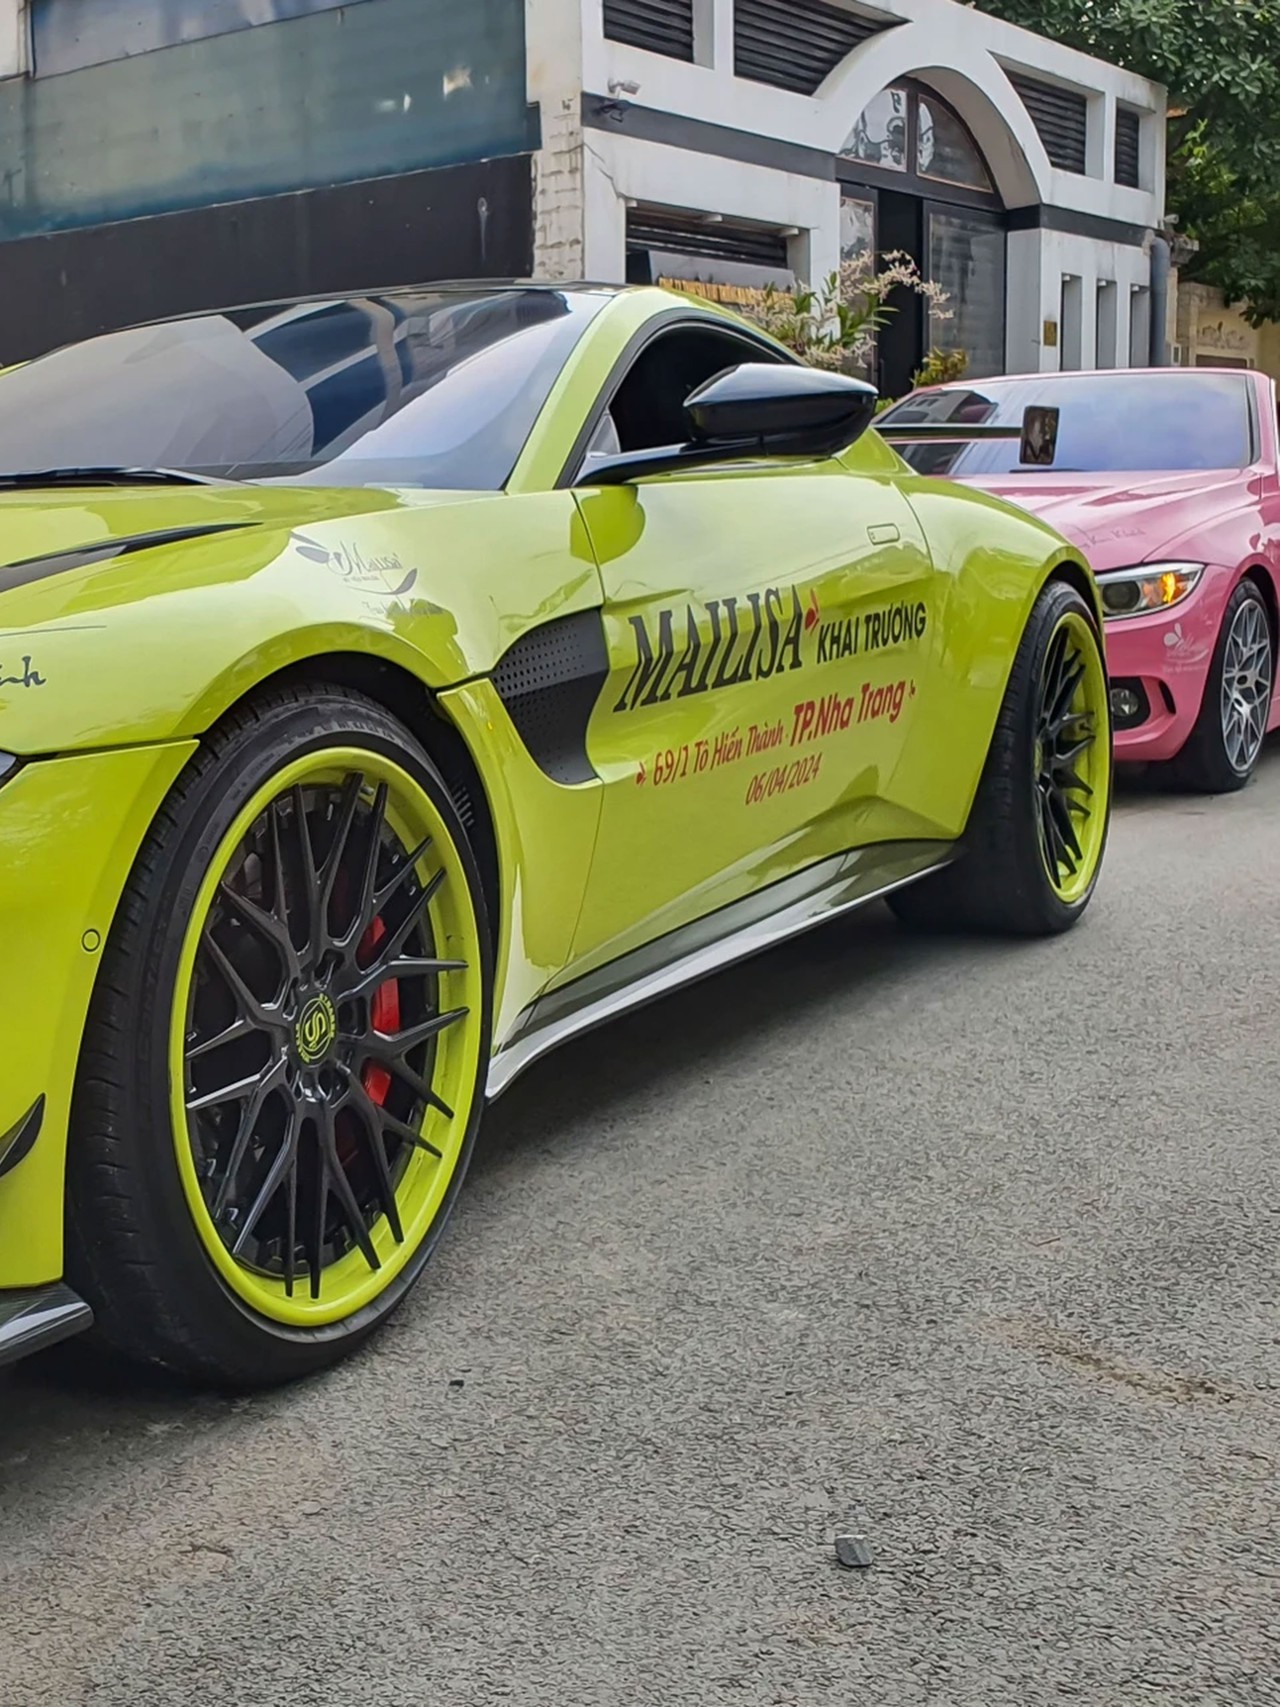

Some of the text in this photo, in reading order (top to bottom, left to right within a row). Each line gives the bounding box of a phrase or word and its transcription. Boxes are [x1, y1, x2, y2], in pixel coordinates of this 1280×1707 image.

[613, 584, 926, 713] MAILISA KHAI TRƯƠNG
[653, 744, 689, 786] 69/1
[693, 739, 709, 774] Tô
[710, 726, 743, 771] Hiến
[857, 680, 906, 723] Trang
[745, 752, 823, 806] 06/04/2024
